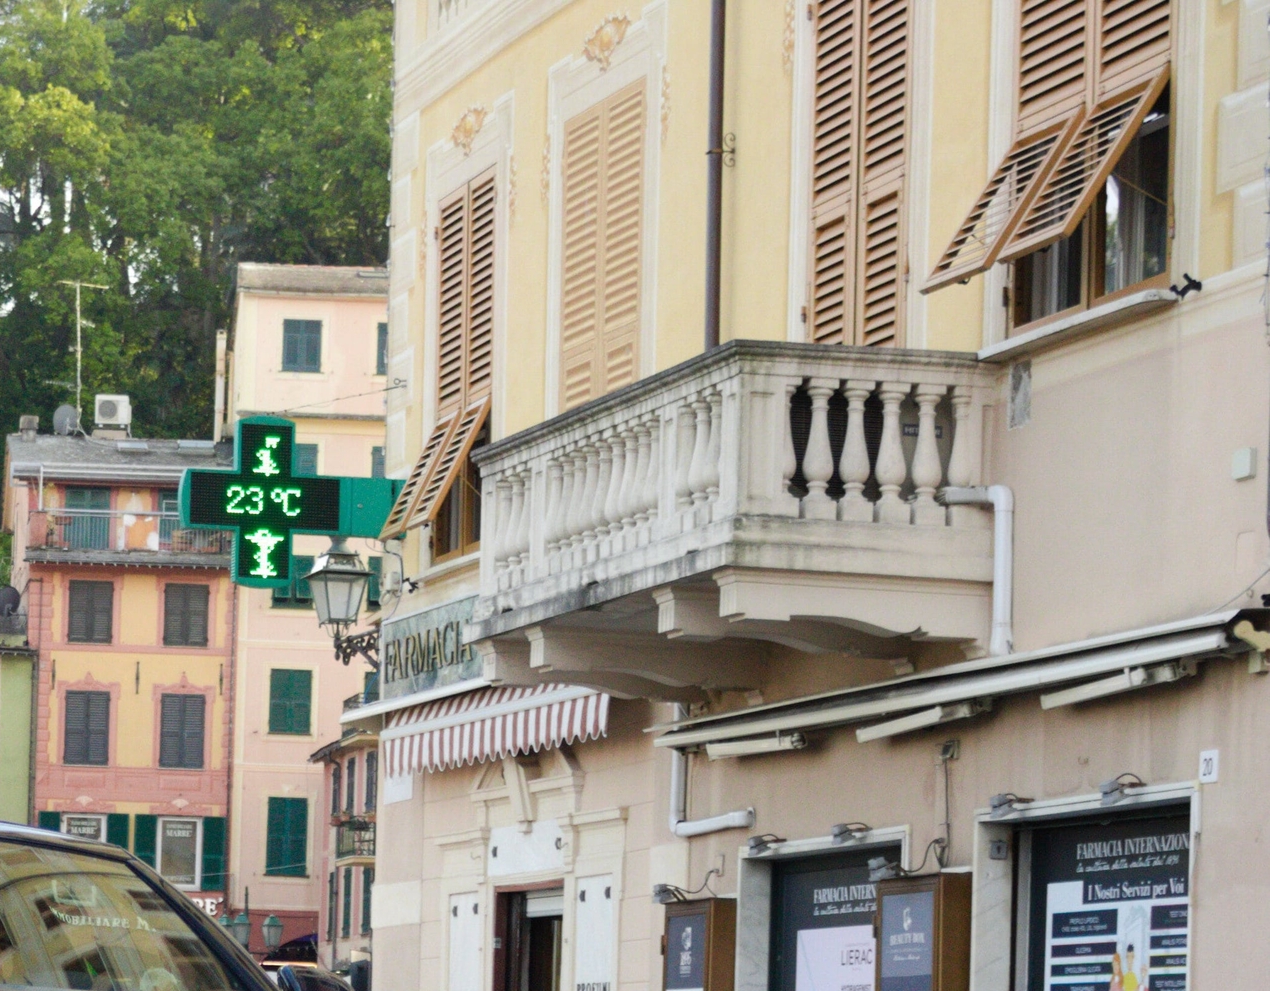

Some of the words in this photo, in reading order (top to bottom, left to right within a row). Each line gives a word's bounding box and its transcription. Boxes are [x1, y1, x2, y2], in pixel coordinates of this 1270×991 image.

[226, 485, 264, 515] 23
[1202, 757, 1214, 776] 20
[1077, 840, 1123, 860] FARMACIA
[813, 886, 849, 904] FARMACIA
[1094, 883, 1121, 901] Nostri
[1122, 881, 1151, 899] Servizi
[1152, 884, 1168, 899] per
[1169, 878, 1185, 895] Voi
[889, 934, 911, 947] BEAUTY
[841, 949, 873, 966] LIERAC
